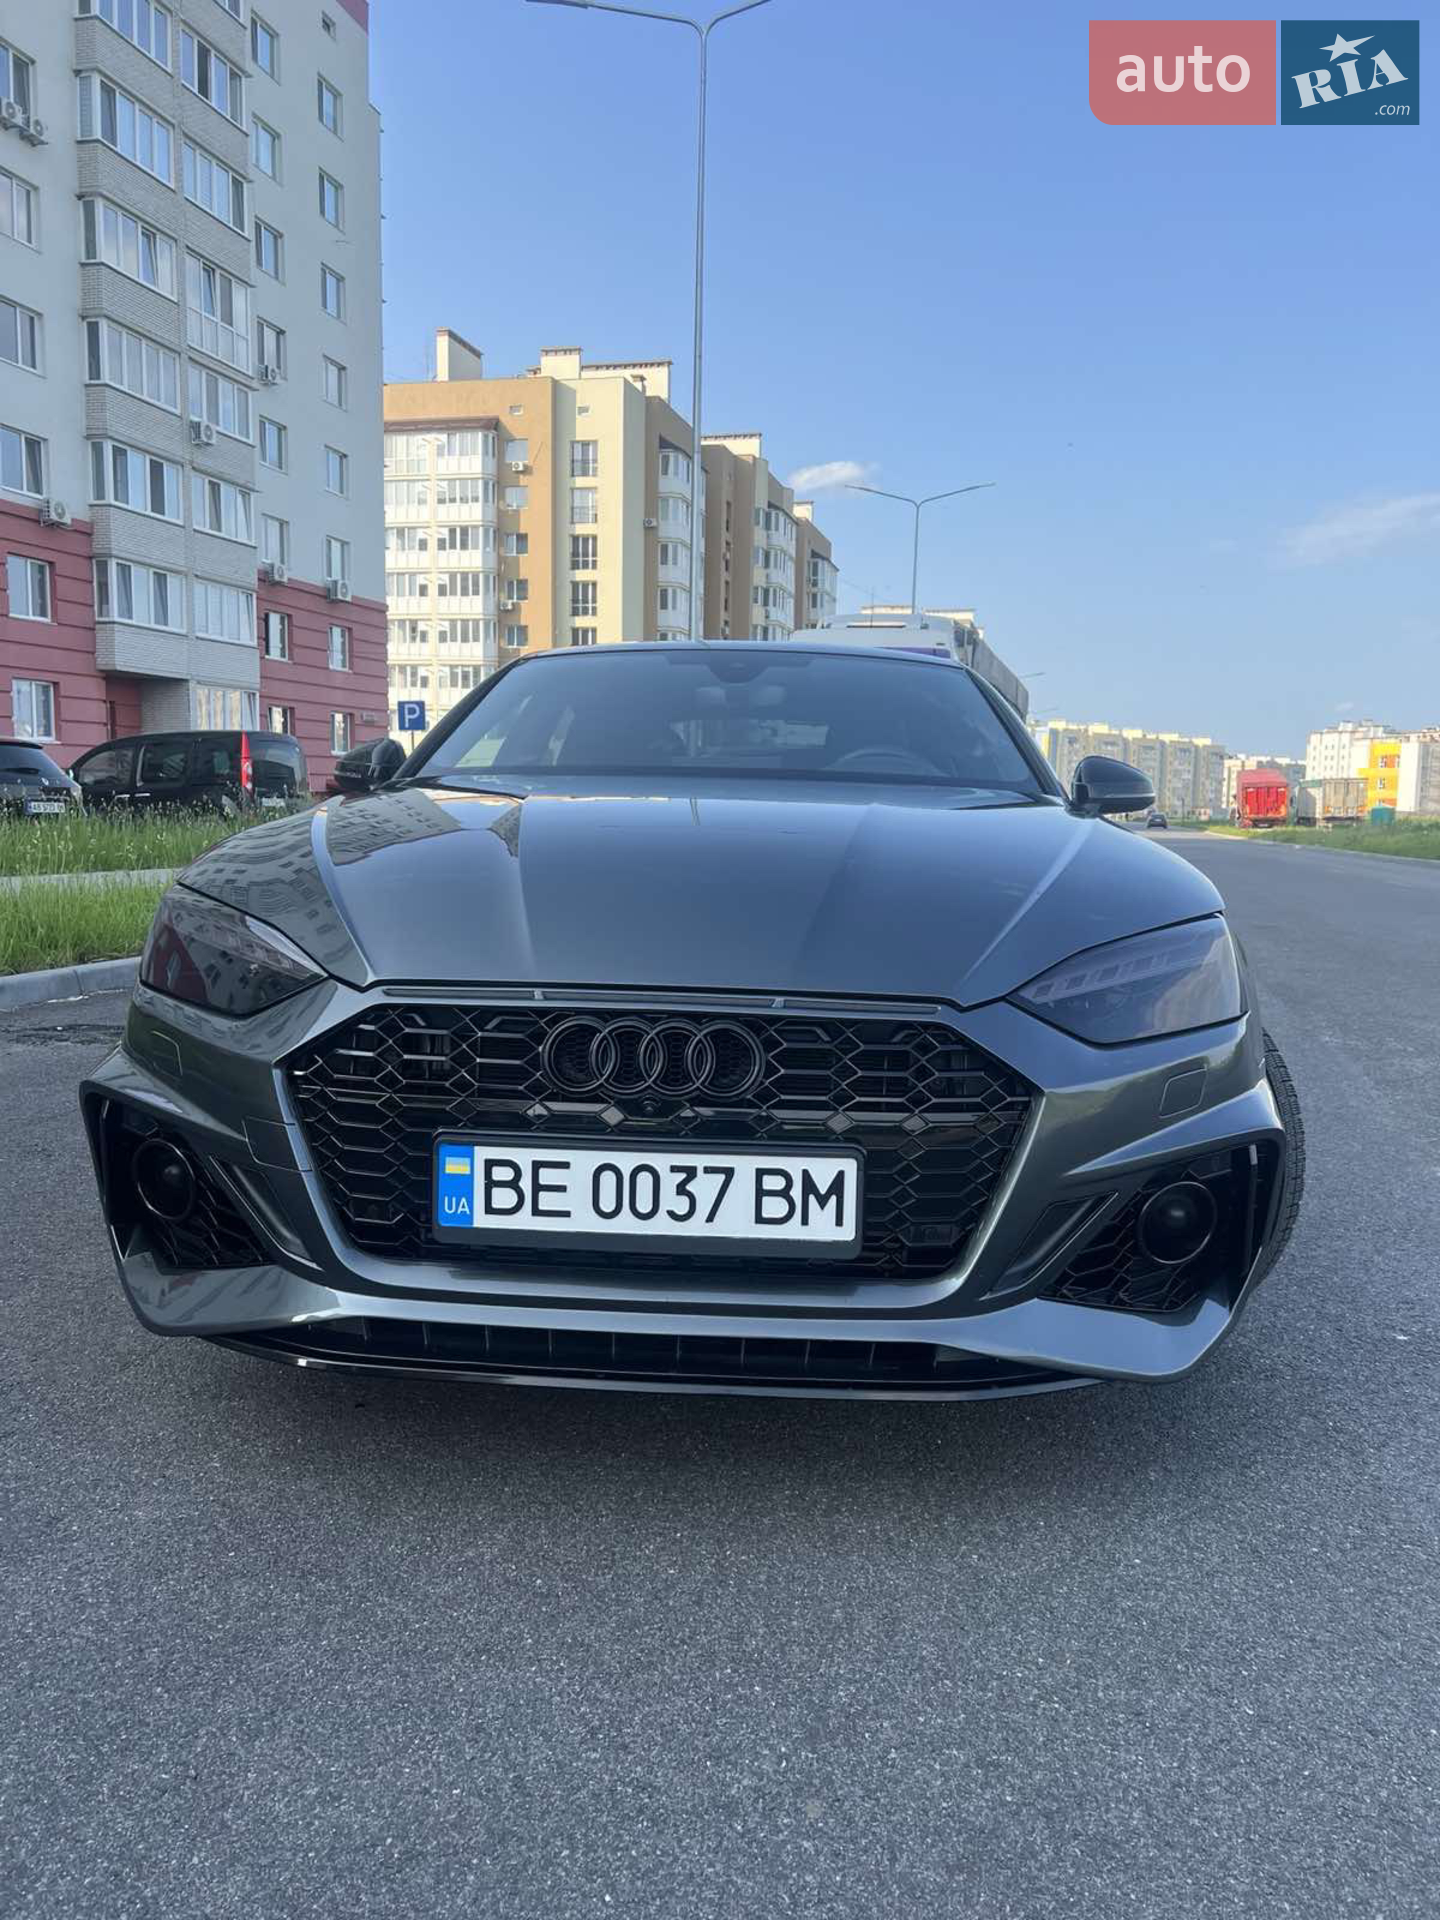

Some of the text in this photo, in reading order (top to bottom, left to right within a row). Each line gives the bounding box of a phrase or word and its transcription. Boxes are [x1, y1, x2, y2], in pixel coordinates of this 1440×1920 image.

[403, 703, 420, 728] P
[443, 1195, 470, 1215] UA
[483, 1158, 846, 1228] BE 0037 BM
